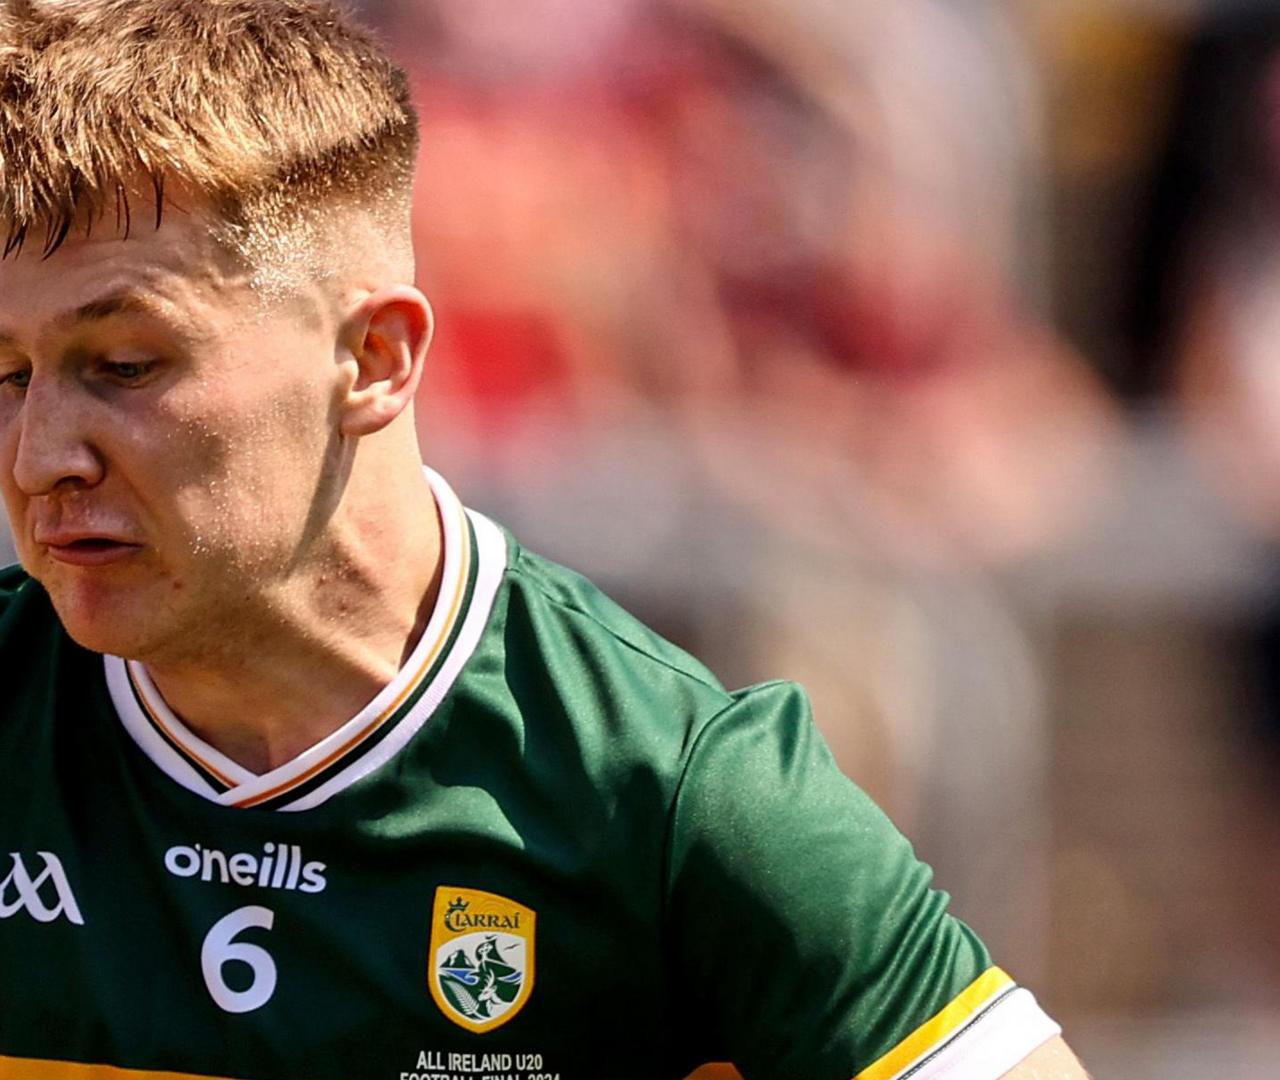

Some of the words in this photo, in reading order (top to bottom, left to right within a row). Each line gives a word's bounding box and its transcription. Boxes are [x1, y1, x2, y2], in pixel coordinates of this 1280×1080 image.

[201, 905, 278, 1013] 6
[416, 1051, 445, 1070] ALL
[448, 1053, 512, 1072] IRELAND
[516, 1054, 543, 1070] U20
